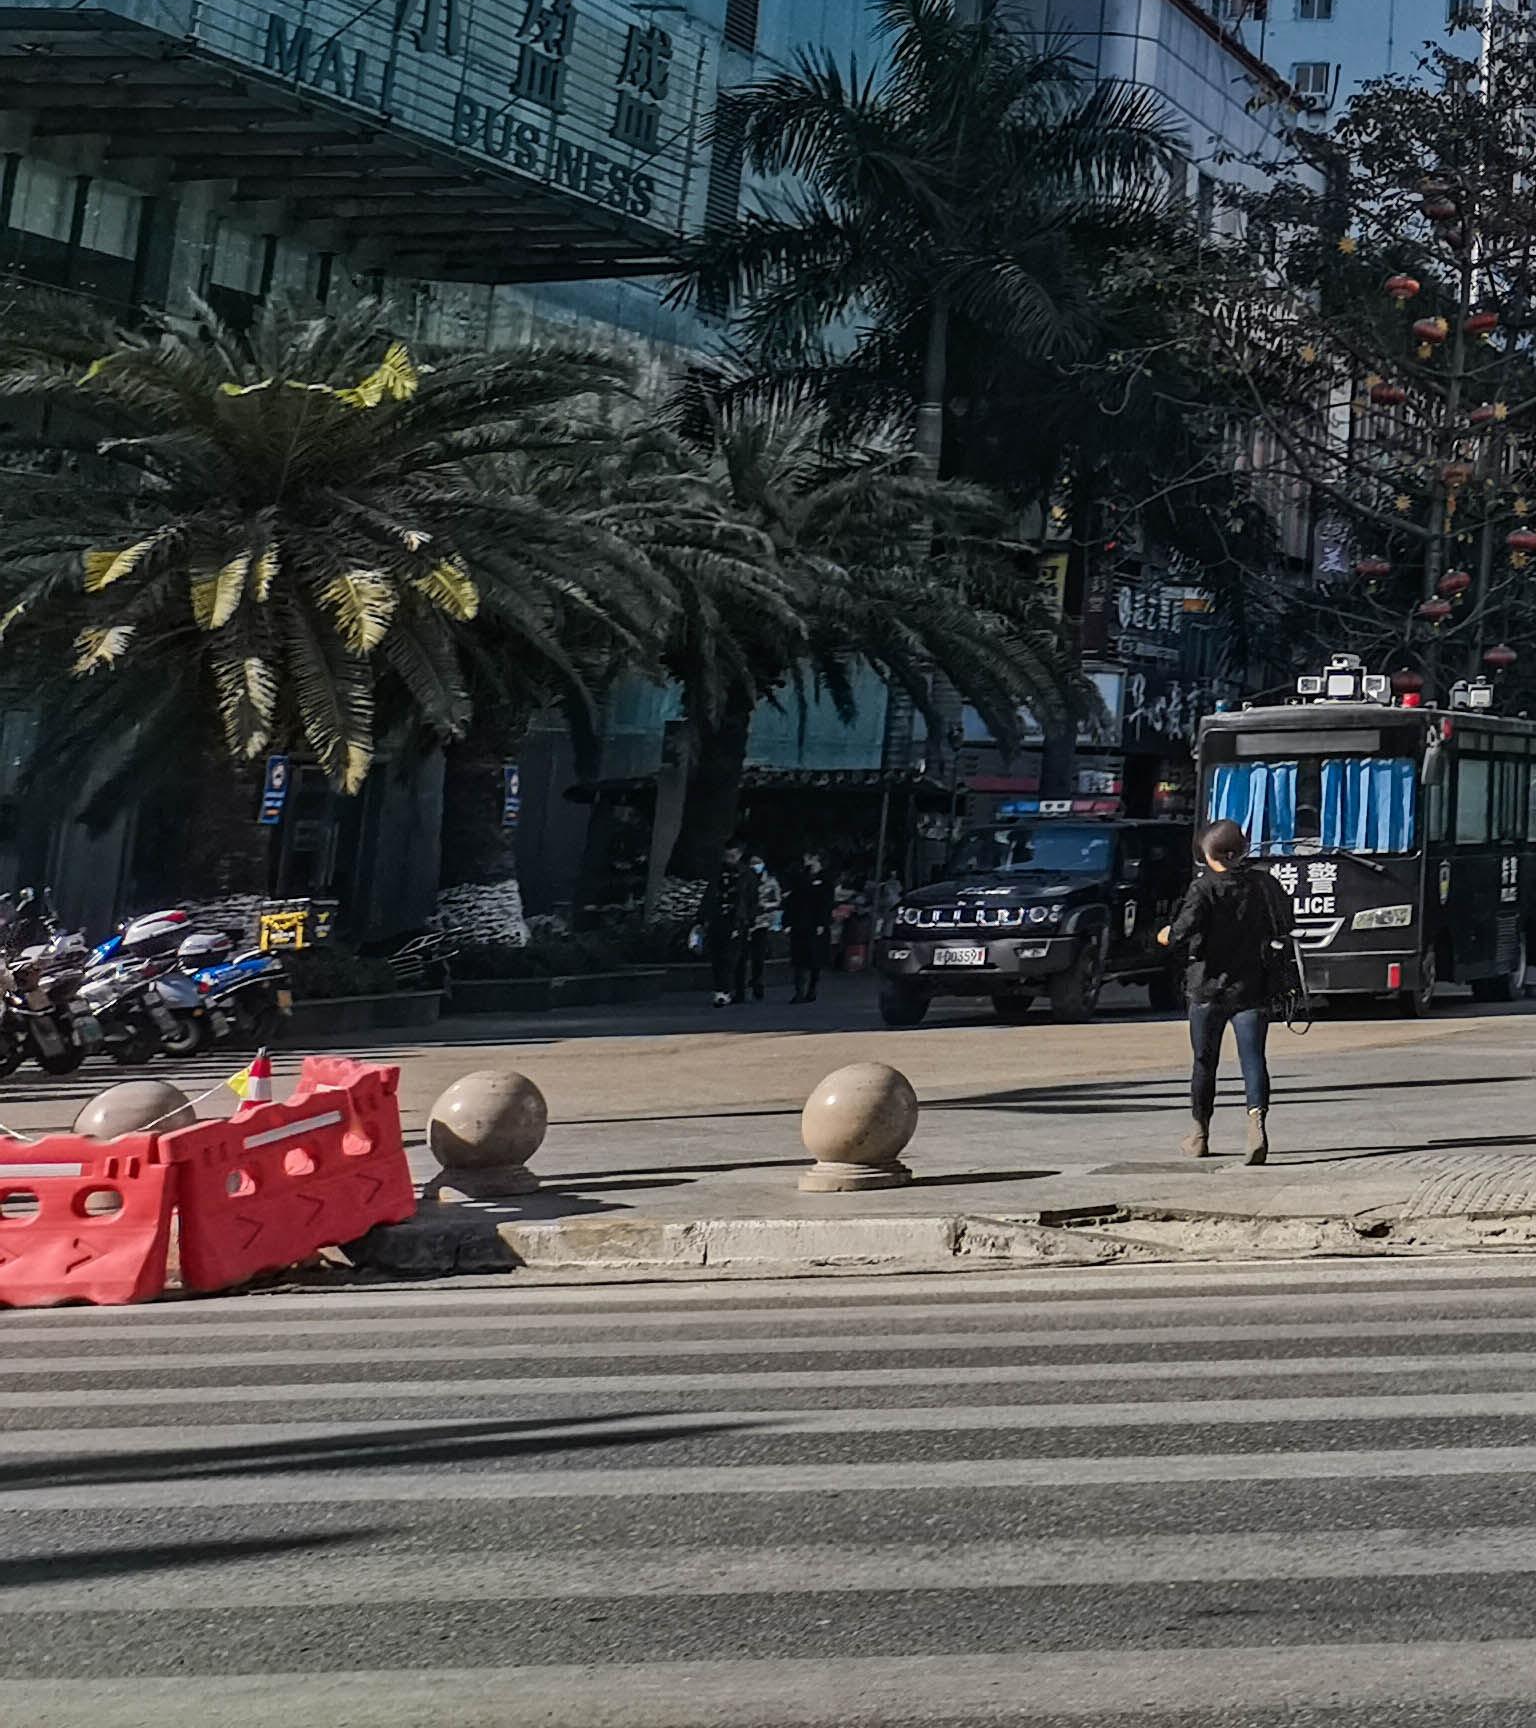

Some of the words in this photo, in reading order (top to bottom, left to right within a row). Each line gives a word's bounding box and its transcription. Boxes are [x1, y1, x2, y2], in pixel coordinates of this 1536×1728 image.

[264, 13, 397, 119] MALL
[453, 92, 656, 219] BUSINESS
[1269, 861, 1338, 895] 特警
